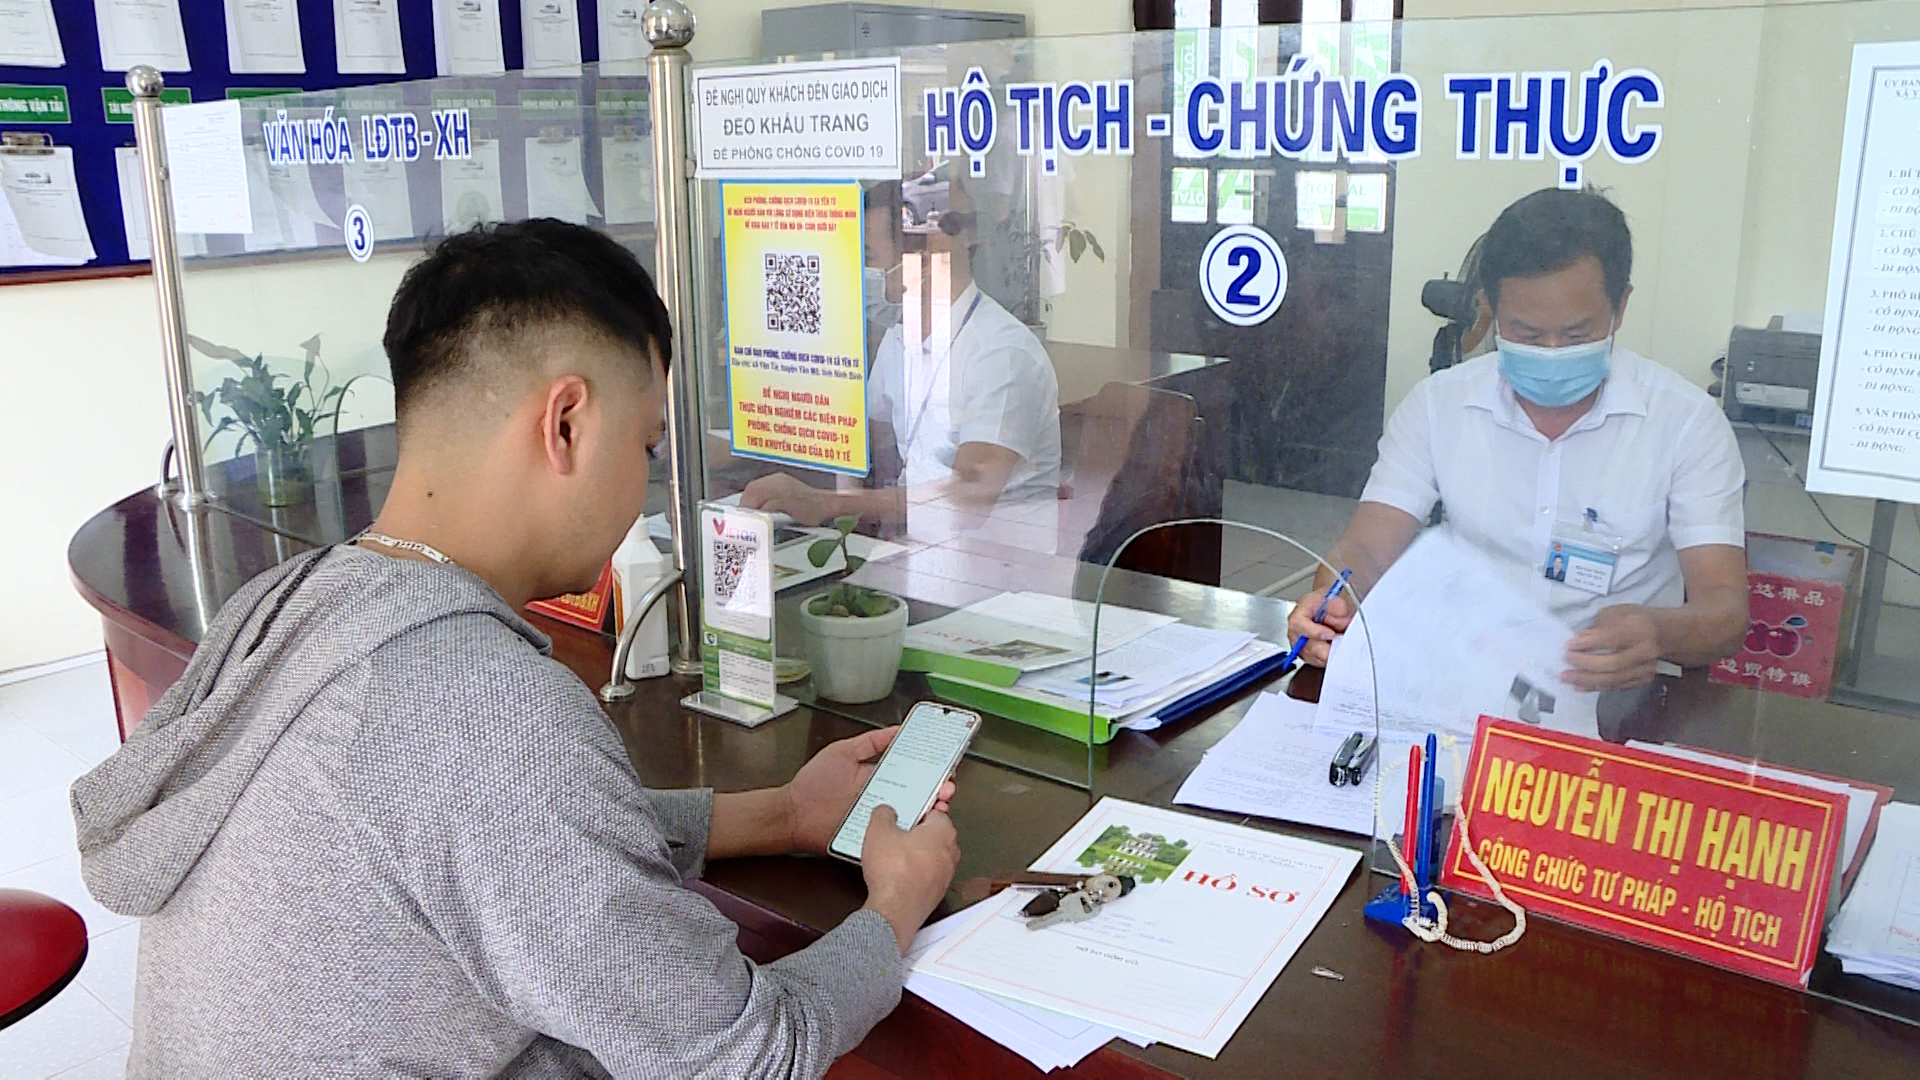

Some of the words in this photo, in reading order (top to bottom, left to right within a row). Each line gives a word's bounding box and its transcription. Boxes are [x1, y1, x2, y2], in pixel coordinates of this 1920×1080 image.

[721, 88, 744, 109] NGHỊ
[769, 81, 805, 102] KHÁCH
[807, 80, 829, 101] ĐẾN
[832, 80, 858, 100] GIAO
[862, 79, 888, 103] DỊCH
[264, 111, 305, 164] VĂN
[309, 107, 354, 162] HÓA
[723, 117, 755, 136] ĐEO
[760, 112, 804, 134] KHẨU
[810, 113, 869, 133] TRANG
[925, 68, 995, 175] HỘ
[1008, 81, 1131, 173] TỊCH
[1187, 56, 1418, 157] CHỨNG
[1447, 62, 1662, 186] THỰC
[731, 145, 773, 160] PHÒNG
[825, 145, 865, 158] COVID
[870, 145, 883, 158] 19
[353, 216, 365, 250] 3
[1226, 246, 1262, 306] 2
[1479, 756, 1627, 845] NGUYỄN
[1632, 793, 1695, 875] THỊ
[1697, 807, 1813, 892] HẠNH
[1183, 870, 1238, 891] HỒ
[1245, 885, 1301, 904] SƠ
[1478, 837, 1529, 880] CÔNG
[1533, 853, 1588, 896] CHỨC
[1592, 867, 1621, 902] TƯ
[1619, 876, 1677, 917] PHÁP
[1694, 895, 1727, 940] HỘ
[1732, 905, 1783, 948] TỊCH
